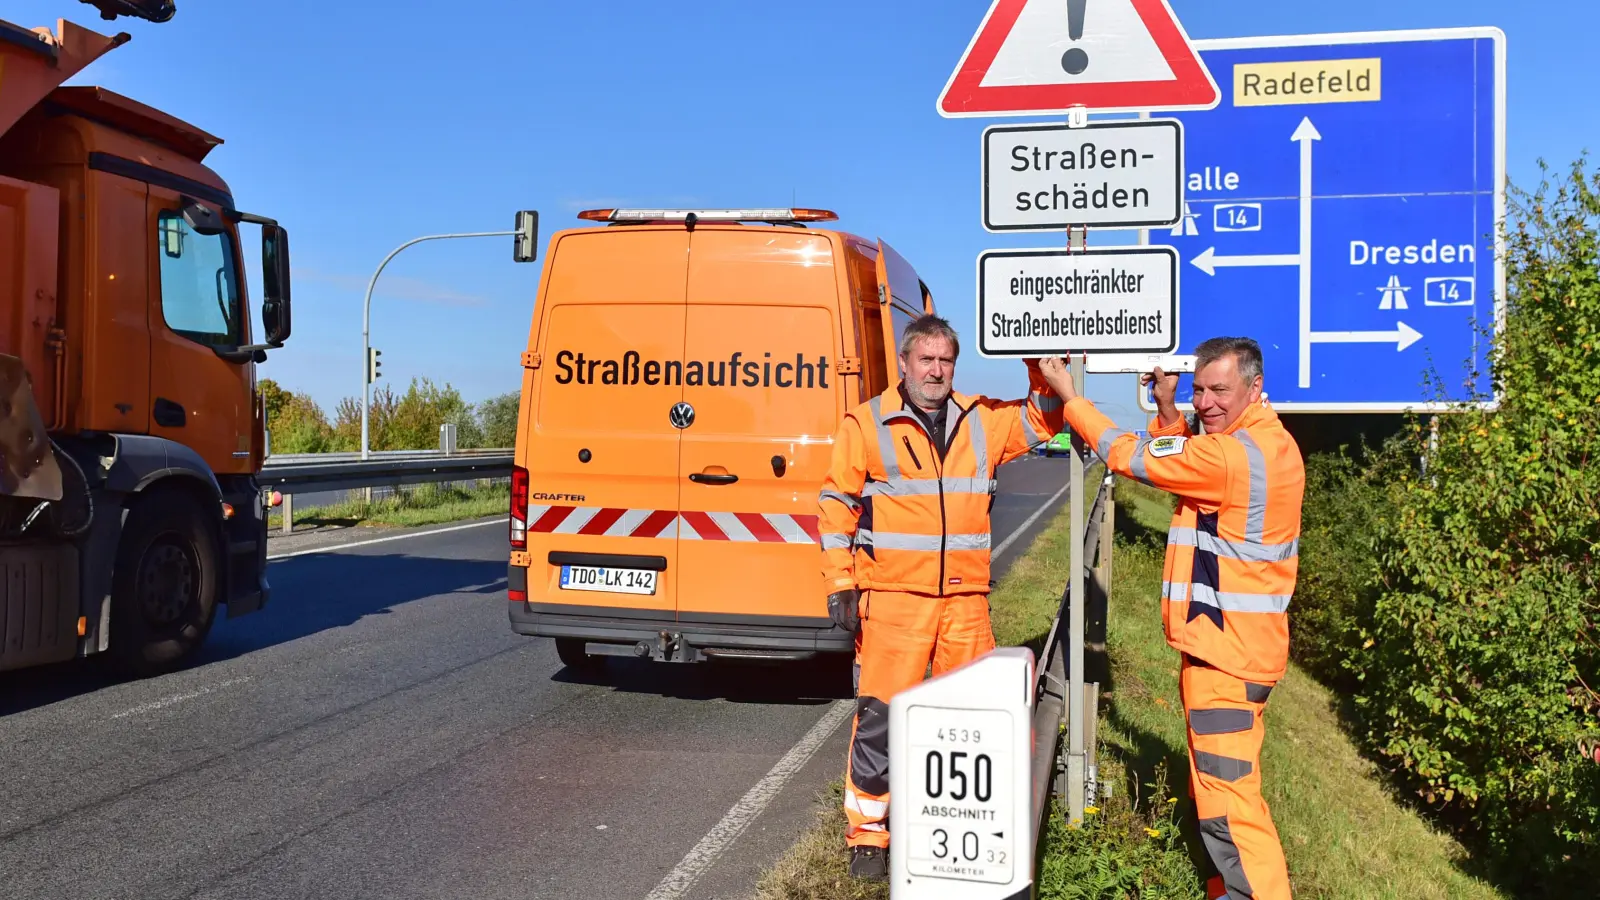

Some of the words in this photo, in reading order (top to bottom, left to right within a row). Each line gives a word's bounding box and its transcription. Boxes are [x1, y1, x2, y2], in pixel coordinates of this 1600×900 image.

[1243, 68, 1371, 97] Radefeld
[1010, 142, 1154, 172] Straßen-
[1187, 166, 1240, 191] alle
[1015, 182, 1149, 211] schäden
[1227, 208, 1247, 226] 14
[1349, 239, 1475, 265] Dresden
[1010, 268, 1144, 302] eingeschränkter
[1438, 283, 1460, 301] 14
[991, 309, 1163, 338] Straßenbetriebsdienst
[555, 350, 830, 389] Straßenaufsicht
[532, 492, 586, 502] CRAFTER
[571, 568, 597, 584] TDO
[605, 570, 624, 586] LK
[626, 571, 653, 588] 142
[937, 728, 981, 744] 4539
[925, 750, 992, 802] 050
[921, 804, 996, 821] ABSCHNITT
[932, 828, 979, 864] 3,0
[987, 850, 1007, 865] 32
[932, 865, 985, 876] KILOMETER
